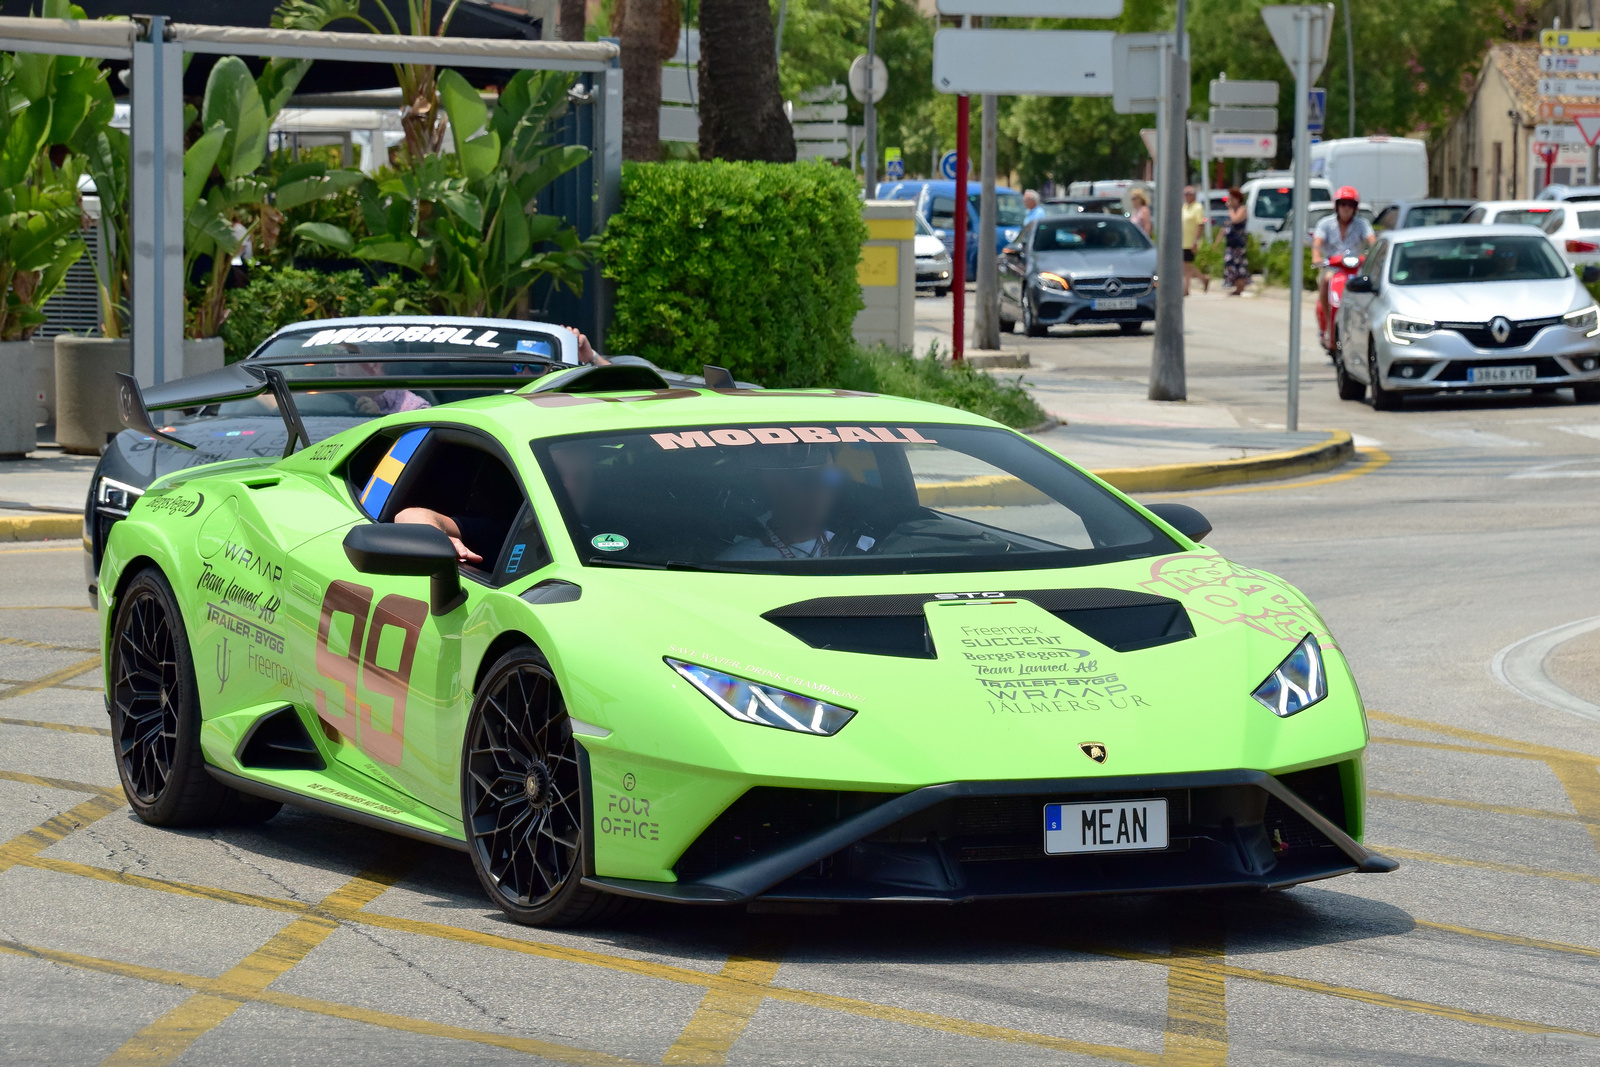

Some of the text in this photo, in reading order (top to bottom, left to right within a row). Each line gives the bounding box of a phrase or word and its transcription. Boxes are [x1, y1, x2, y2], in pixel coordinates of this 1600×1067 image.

[301, 326, 500, 348] MODBALL
[650, 426, 938, 450] MODBALL
[605, 535, 615, 543] 4
[197, 561, 226, 595] Team
[934, 591, 1006, 600] STO
[206, 601, 286, 655] TRAILER-BYGG
[960, 625, 1043, 637] Freemax
[960, 635, 1062, 648] SUCCENT
[248, 644, 296, 690] Freemax
[315, 579, 430, 768] 99
[668, 644, 699, 658] SAVE
[744, 664, 783, 681] DRINK
[785, 675, 867, 704] CHAMPAGNE!
[971, 660, 1099, 676] Team Lanned AB
[975, 673, 1120, 689] TRAILER-BYGG
[1108, 694, 1152, 711] UR
[608, 794, 651, 818] FOUR
[600, 816, 660, 841] OFFICE
[1082, 807, 1148, 846] MEAN
